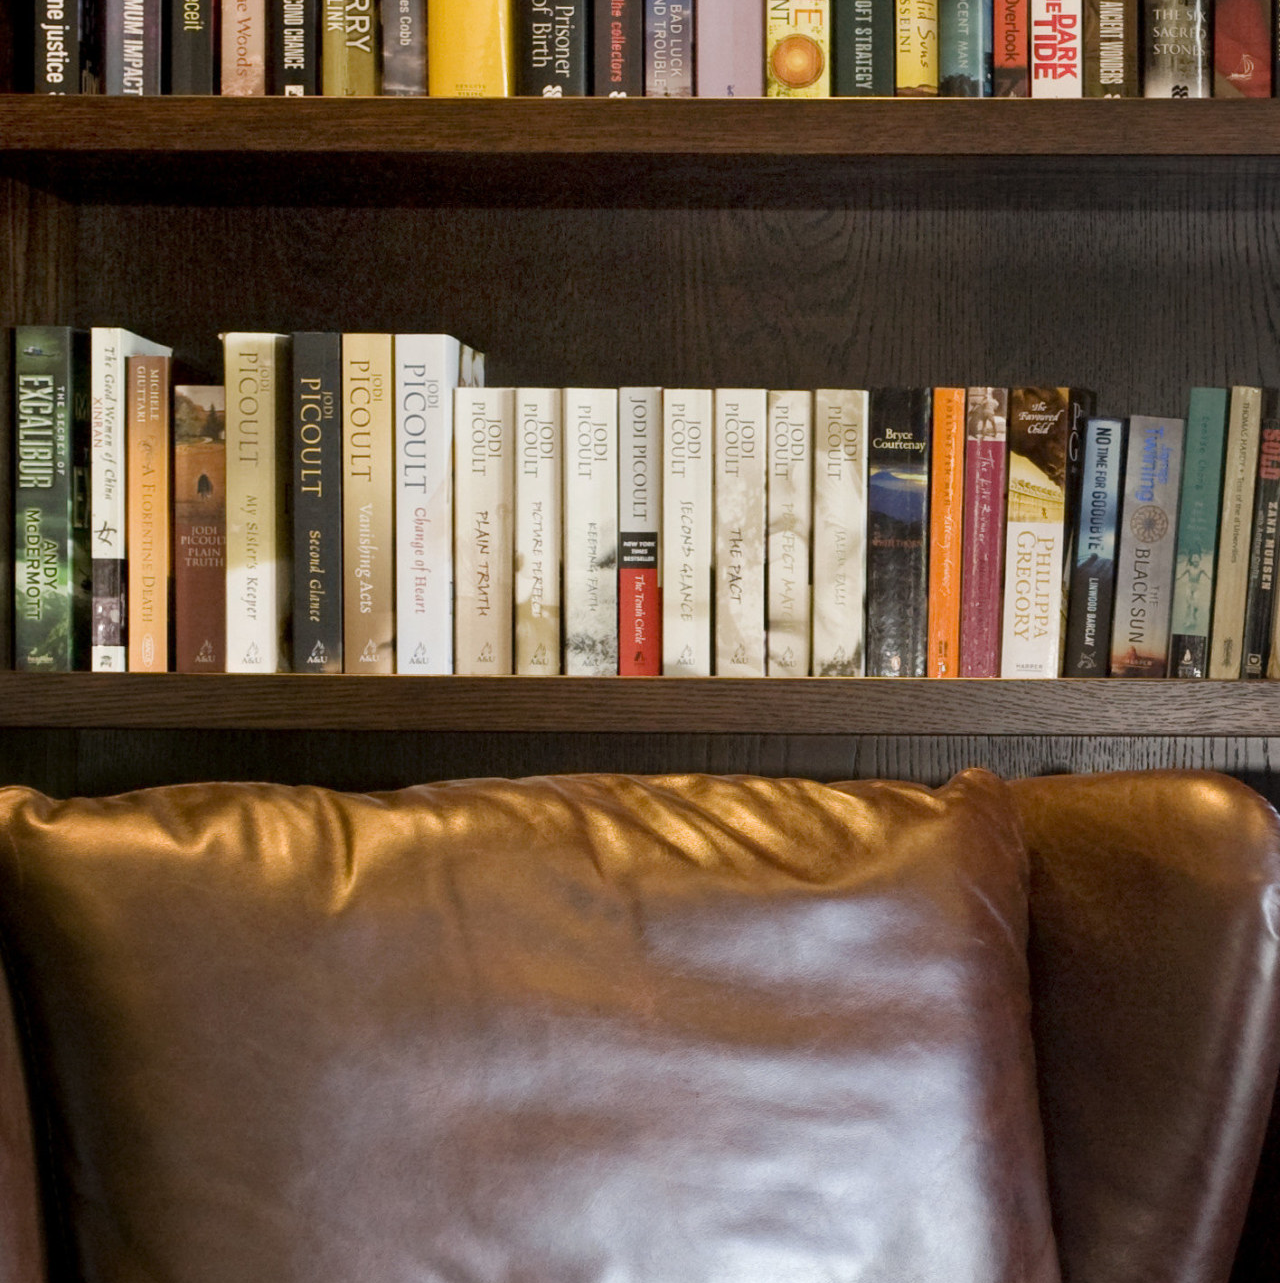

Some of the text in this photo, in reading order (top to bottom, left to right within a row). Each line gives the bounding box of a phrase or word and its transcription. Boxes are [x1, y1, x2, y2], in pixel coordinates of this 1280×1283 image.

[41, 22, 70, 84] justice
[122, 39, 143, 96] IMPACT
[653, 21, 667, 87] TROUBLE
[669, 4, 683, 77] BAD LUCK
[1033, 18, 1058, 80] TIDE
[1056, 14, 1078, 79] DARK
[238, 352, 258, 466] PICOULT
[350, 360, 373, 483] PICOULT
[371, 373, 383, 402] JODI
[426, 379, 439, 409] JODI
[19, 374, 54, 489] EXCALIBUR
[300, 377, 322, 498] PICOULT
[403, 363, 427, 494] PICOULT
[471, 401, 487, 477] PICOULT
[487, 418, 502, 459] JODI
[523, 403, 538, 479] PICOULT
[537, 421, 555, 460] JODI
[577, 405, 592, 480] PICOULT
[593, 422, 608, 462] JODI
[629, 396, 648, 522] JODI PICOULT
[671, 403, 686, 479] PICOULT
[687, 421, 701, 460] JODI
[725, 403, 739, 477] PICOULT
[740, 420, 755, 460] JODI
[774, 405, 789, 480] PICOULT
[790, 423, 805, 462] JODI
[827, 406, 842, 480] PICOULT
[844, 423, 858, 462] JODI
[873, 438, 926, 452] Courtenay
[885, 428, 913, 443] Bryce
[25, 510, 41, 620] McDERMOTT
[42, 539, 58, 590] ANDY
[185, 557, 224, 568] TRUTH
[309, 529, 326, 623] Second Glance
[355, 503, 378, 614] Vanishing Acts
[475, 510, 491, 617] PLAIN TRUTH
[728, 528, 743, 605] THE PACT
[1014, 530, 1036, 641] GREGORY
[1033, 537, 1055, 640] PHILIPPA
[1128, 548, 1150, 645] BLACK SUN
